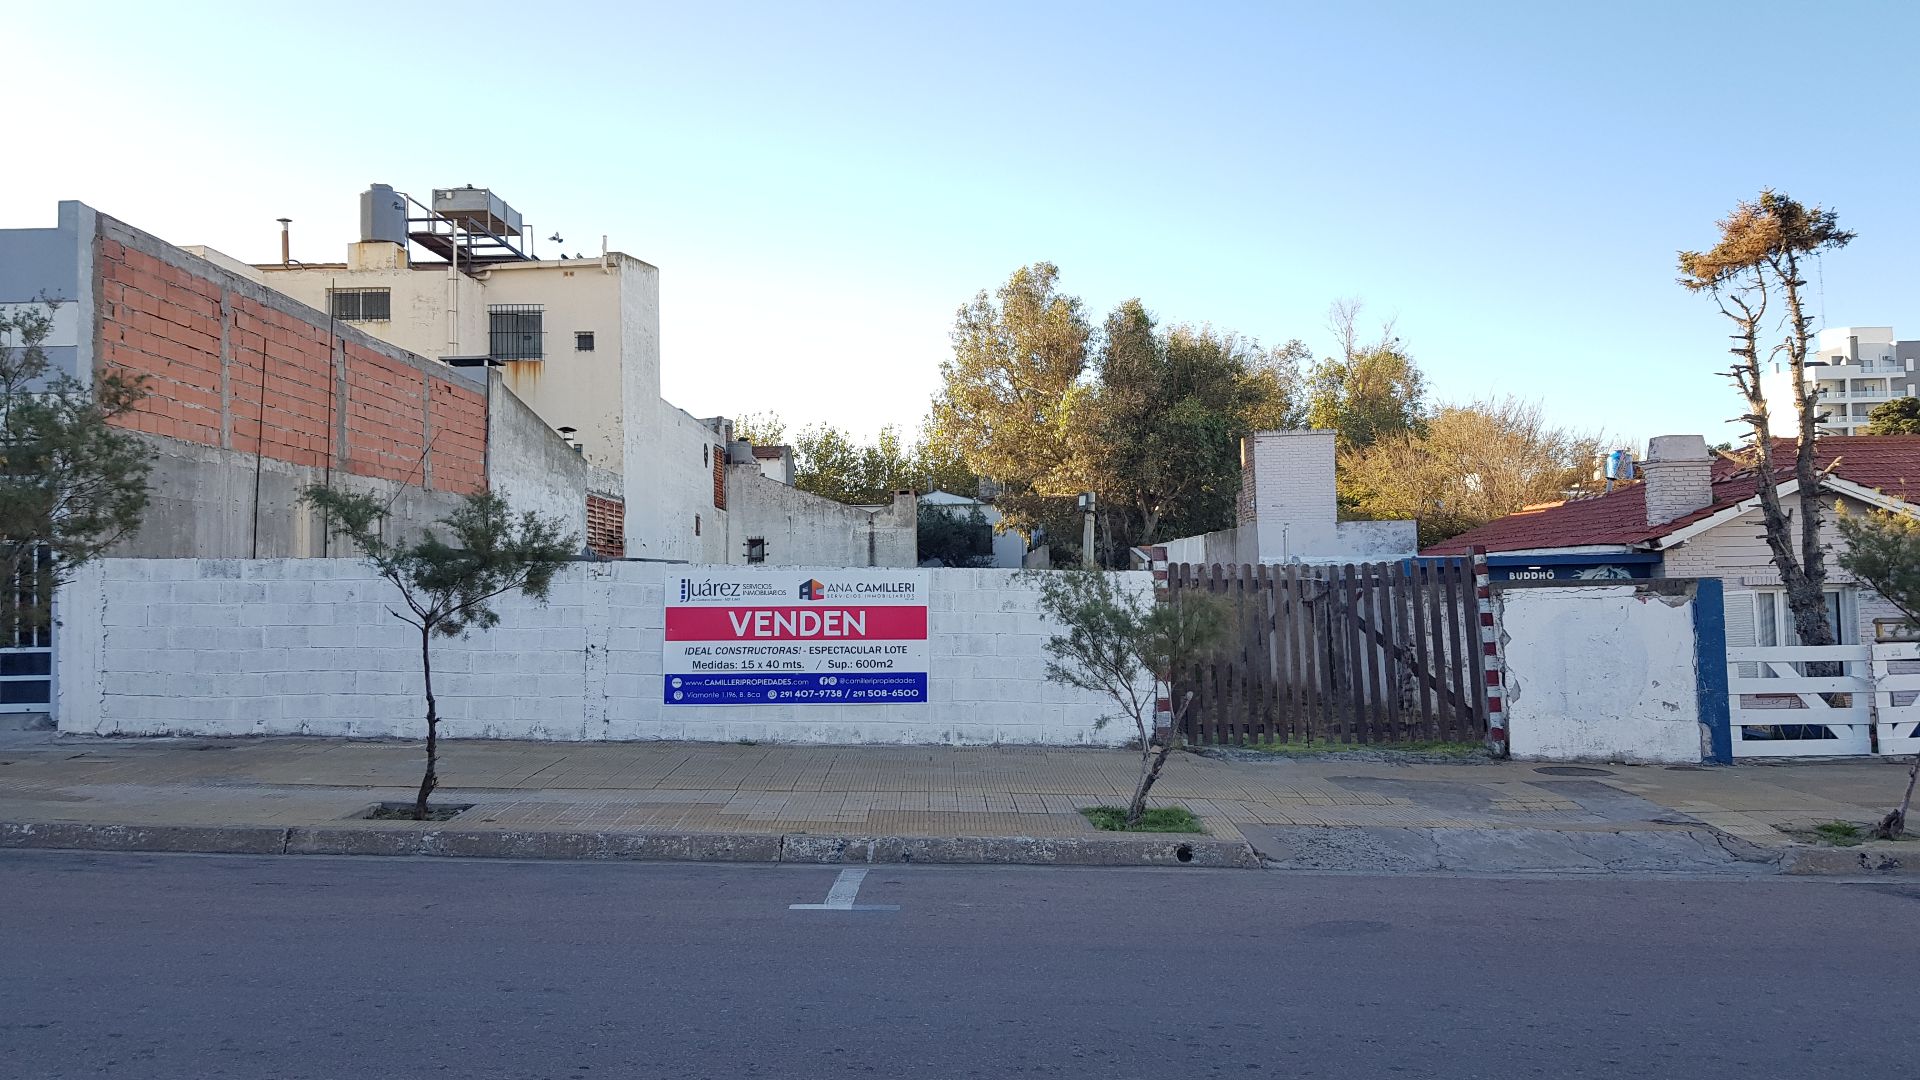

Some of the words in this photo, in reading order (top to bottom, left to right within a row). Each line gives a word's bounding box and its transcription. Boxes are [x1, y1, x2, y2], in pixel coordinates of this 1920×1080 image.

[1509, 569, 1555, 580] BUDDHÔ
[685, 578, 741, 603] Juárez
[742, 589, 787, 597] INMOBILIARIOS
[827, 583, 853, 593] ANA
[855, 582, 915, 593] CAMILLERI
[728, 610, 866, 637] VENDEN
[684, 647, 712, 656] IDEAL
[715, 646, 802, 655] CONSTRUCTORAS!
[809, 646, 882, 655] ESPECTACULAR
[885, 645, 908, 654] LOTE
[692, 660, 738, 669] Medidas:
[741, 660, 754, 669] 15
[757, 661, 763, 669] x
[765, 660, 780, 669] 40
[782, 660, 805, 669] mts.
[828, 659, 853, 671] Sup.:
[855, 659, 893, 669] 600m2
[685, 678, 809, 686] www.CAMILLERIPROPIEDADES.com
[839, 677, 916, 686] @camilleripropiedades
[794, 689, 842, 698] 407-9738
[853, 690, 866, 698] 291
[867, 689, 919, 697] 508-6500
